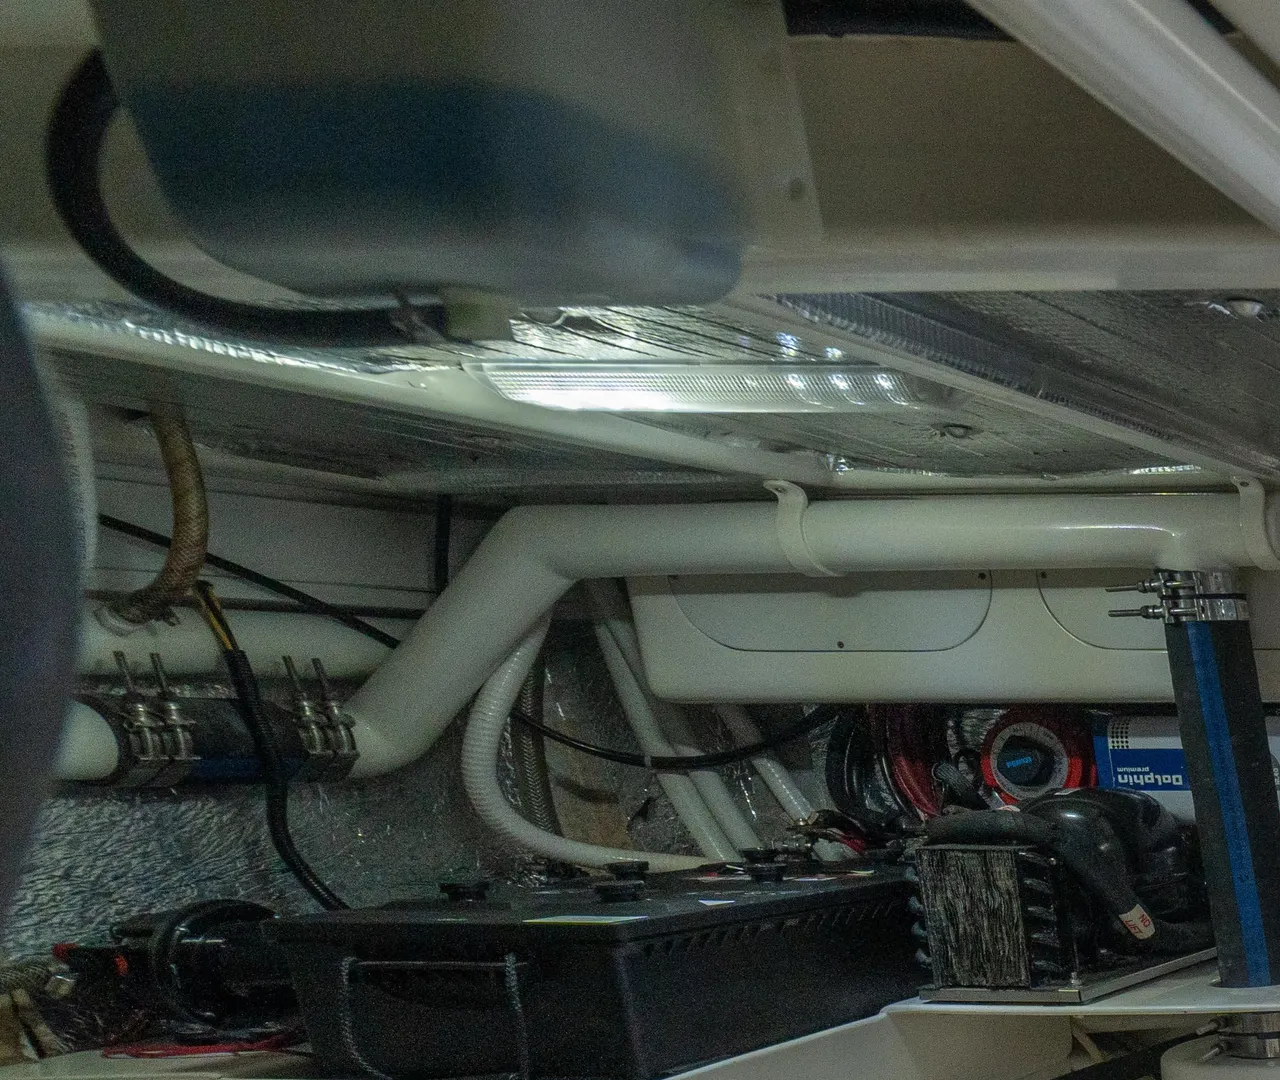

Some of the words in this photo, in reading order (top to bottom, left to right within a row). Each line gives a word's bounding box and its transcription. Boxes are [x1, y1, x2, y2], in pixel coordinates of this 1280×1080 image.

[1118, 773, 1183, 786] Dolphin
[1124, 920, 1143, 933] LIFT
[1139, 914, 1151, 927] NO
